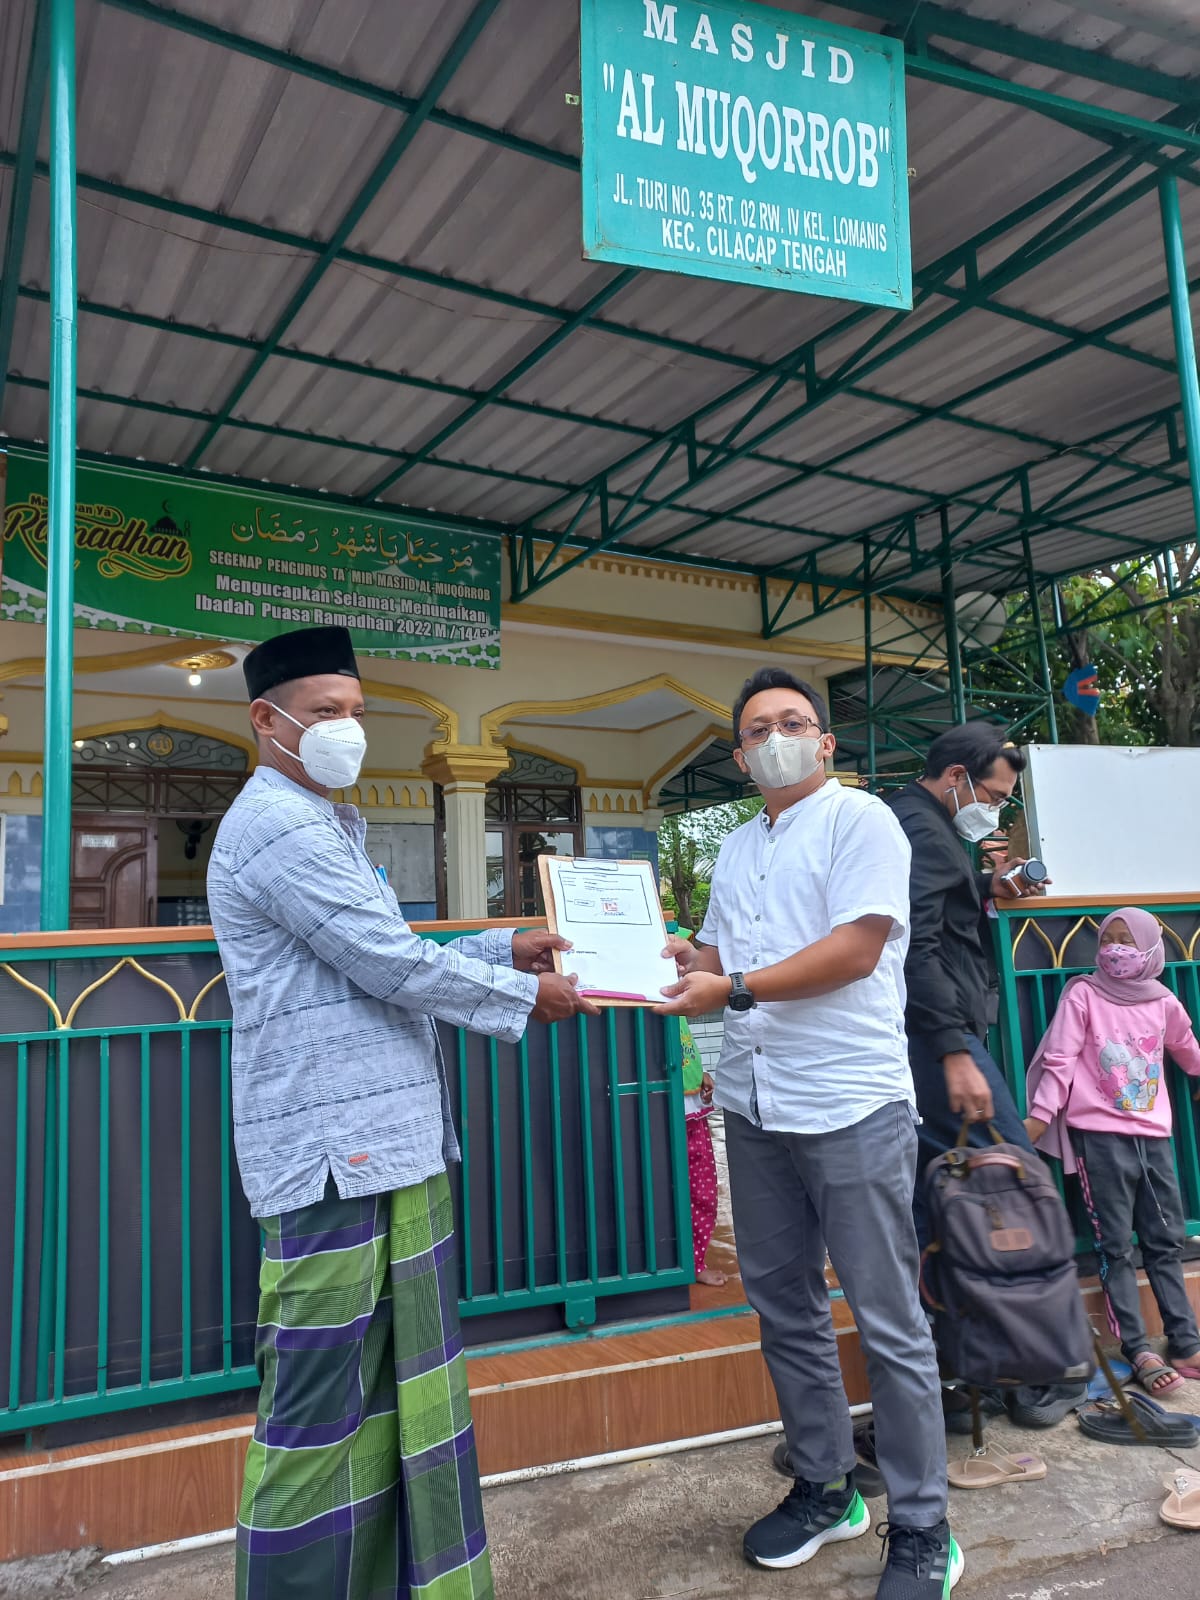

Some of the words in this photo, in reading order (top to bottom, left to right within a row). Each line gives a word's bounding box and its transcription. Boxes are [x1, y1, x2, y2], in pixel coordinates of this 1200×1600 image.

[643, 0, 854, 84] MASJID
[675, 80, 889, 188] MUQORROB"
[613, 172, 633, 206] JL.
[636, 176, 668, 213] TURI
[671, 184, 695, 218] NO.
[699, 190, 714, 221] 35
[717, 193, 737, 226] RT.
[740, 199, 757, 229] 02
[759, 201, 785, 234] RW.
[787, 207, 799, 237] IV
[803, 210, 830, 243] KEL.
[833, 215, 887, 252] LOMANIS
[661, 217, 701, 253] KEC.
[706, 226, 777, 265] CILACAP
[781, 239, 847, 278] TENGAH
[30, 494, 94, 514] Maan
[209, 550, 263, 570] SEGENAP
[267, 558, 327, 579] PENGURUS
[377, 572, 418, 592] MASJID
[216, 574, 331, 604] Mengucapkan
[333, 589, 396, 612] Selamat
[401, 598, 487, 623] Menunaikan
[195, 593, 255, 616] Ibadah
[261, 602, 312, 623] Puasa
[313, 608, 394, 632] Ramadhan
[397, 617, 432, 636] 2022
[435, 622, 447, 638] M
